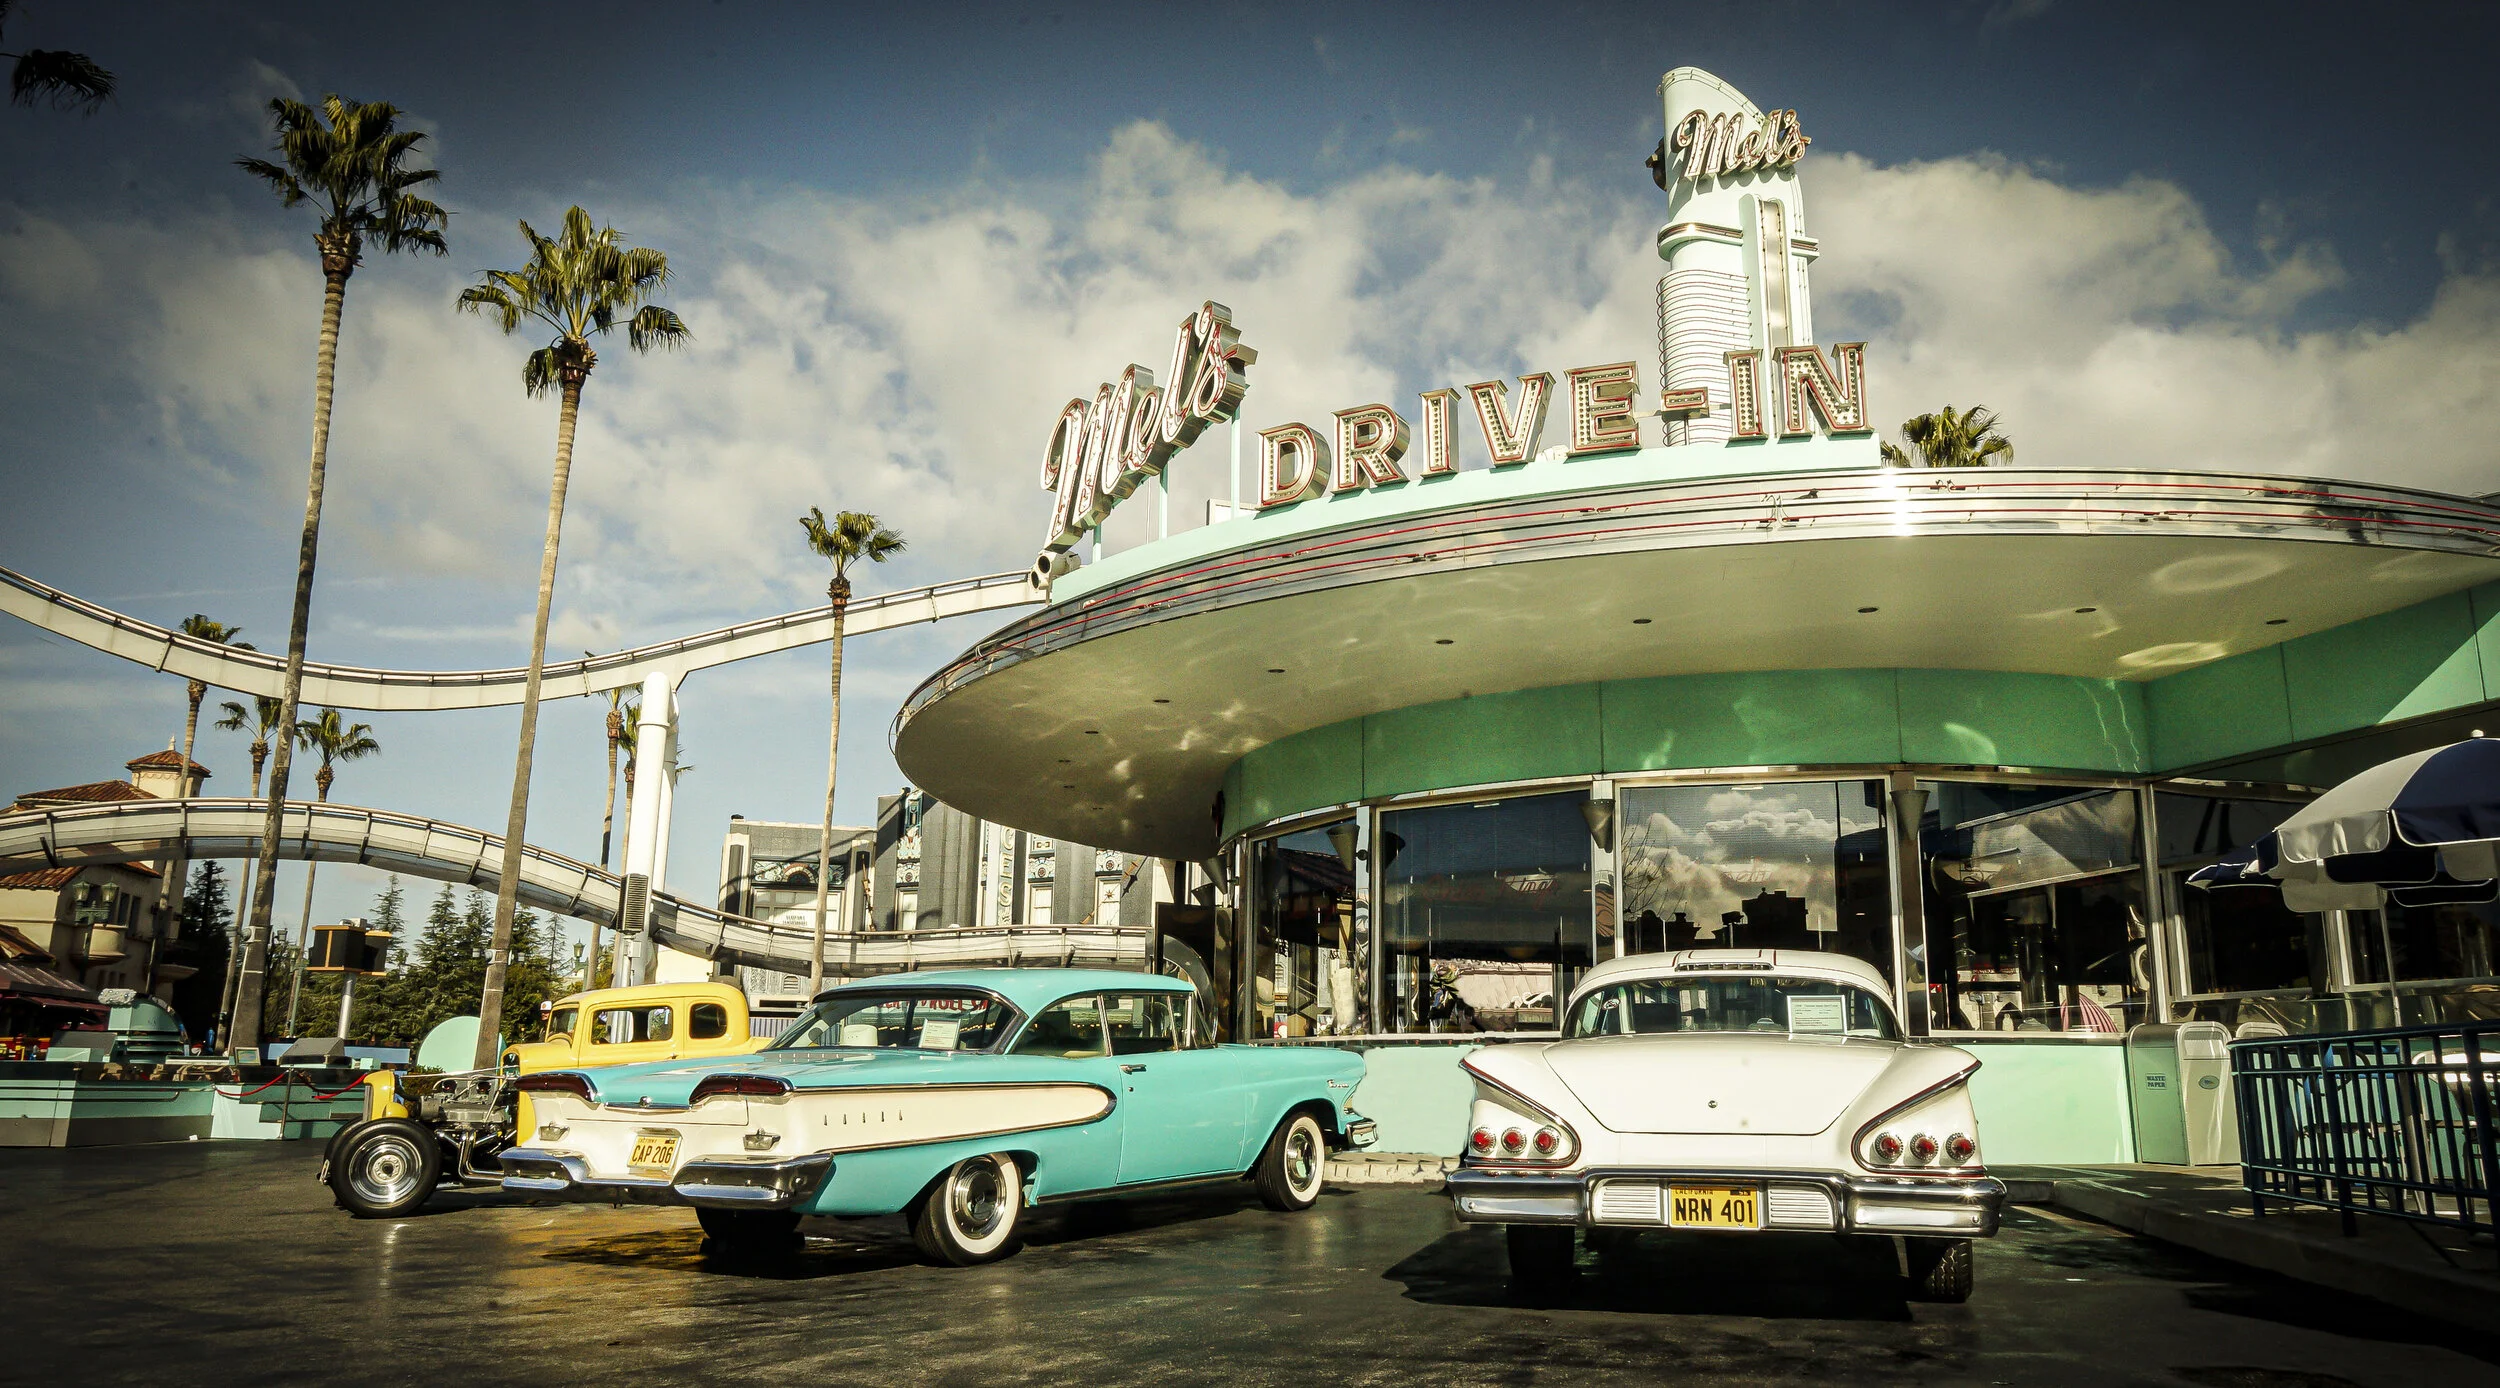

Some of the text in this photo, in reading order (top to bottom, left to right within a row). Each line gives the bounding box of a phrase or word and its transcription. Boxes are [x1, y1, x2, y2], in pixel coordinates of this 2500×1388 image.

[1671, 108, 1812, 178] Mel's
[1040, 300, 1258, 553] Mel's
[1256, 342, 1875, 510] DRIVE-IN
[632, 1145, 674, 1164] CAP 206
[1675, 1198, 1753, 1223] NRN 401
